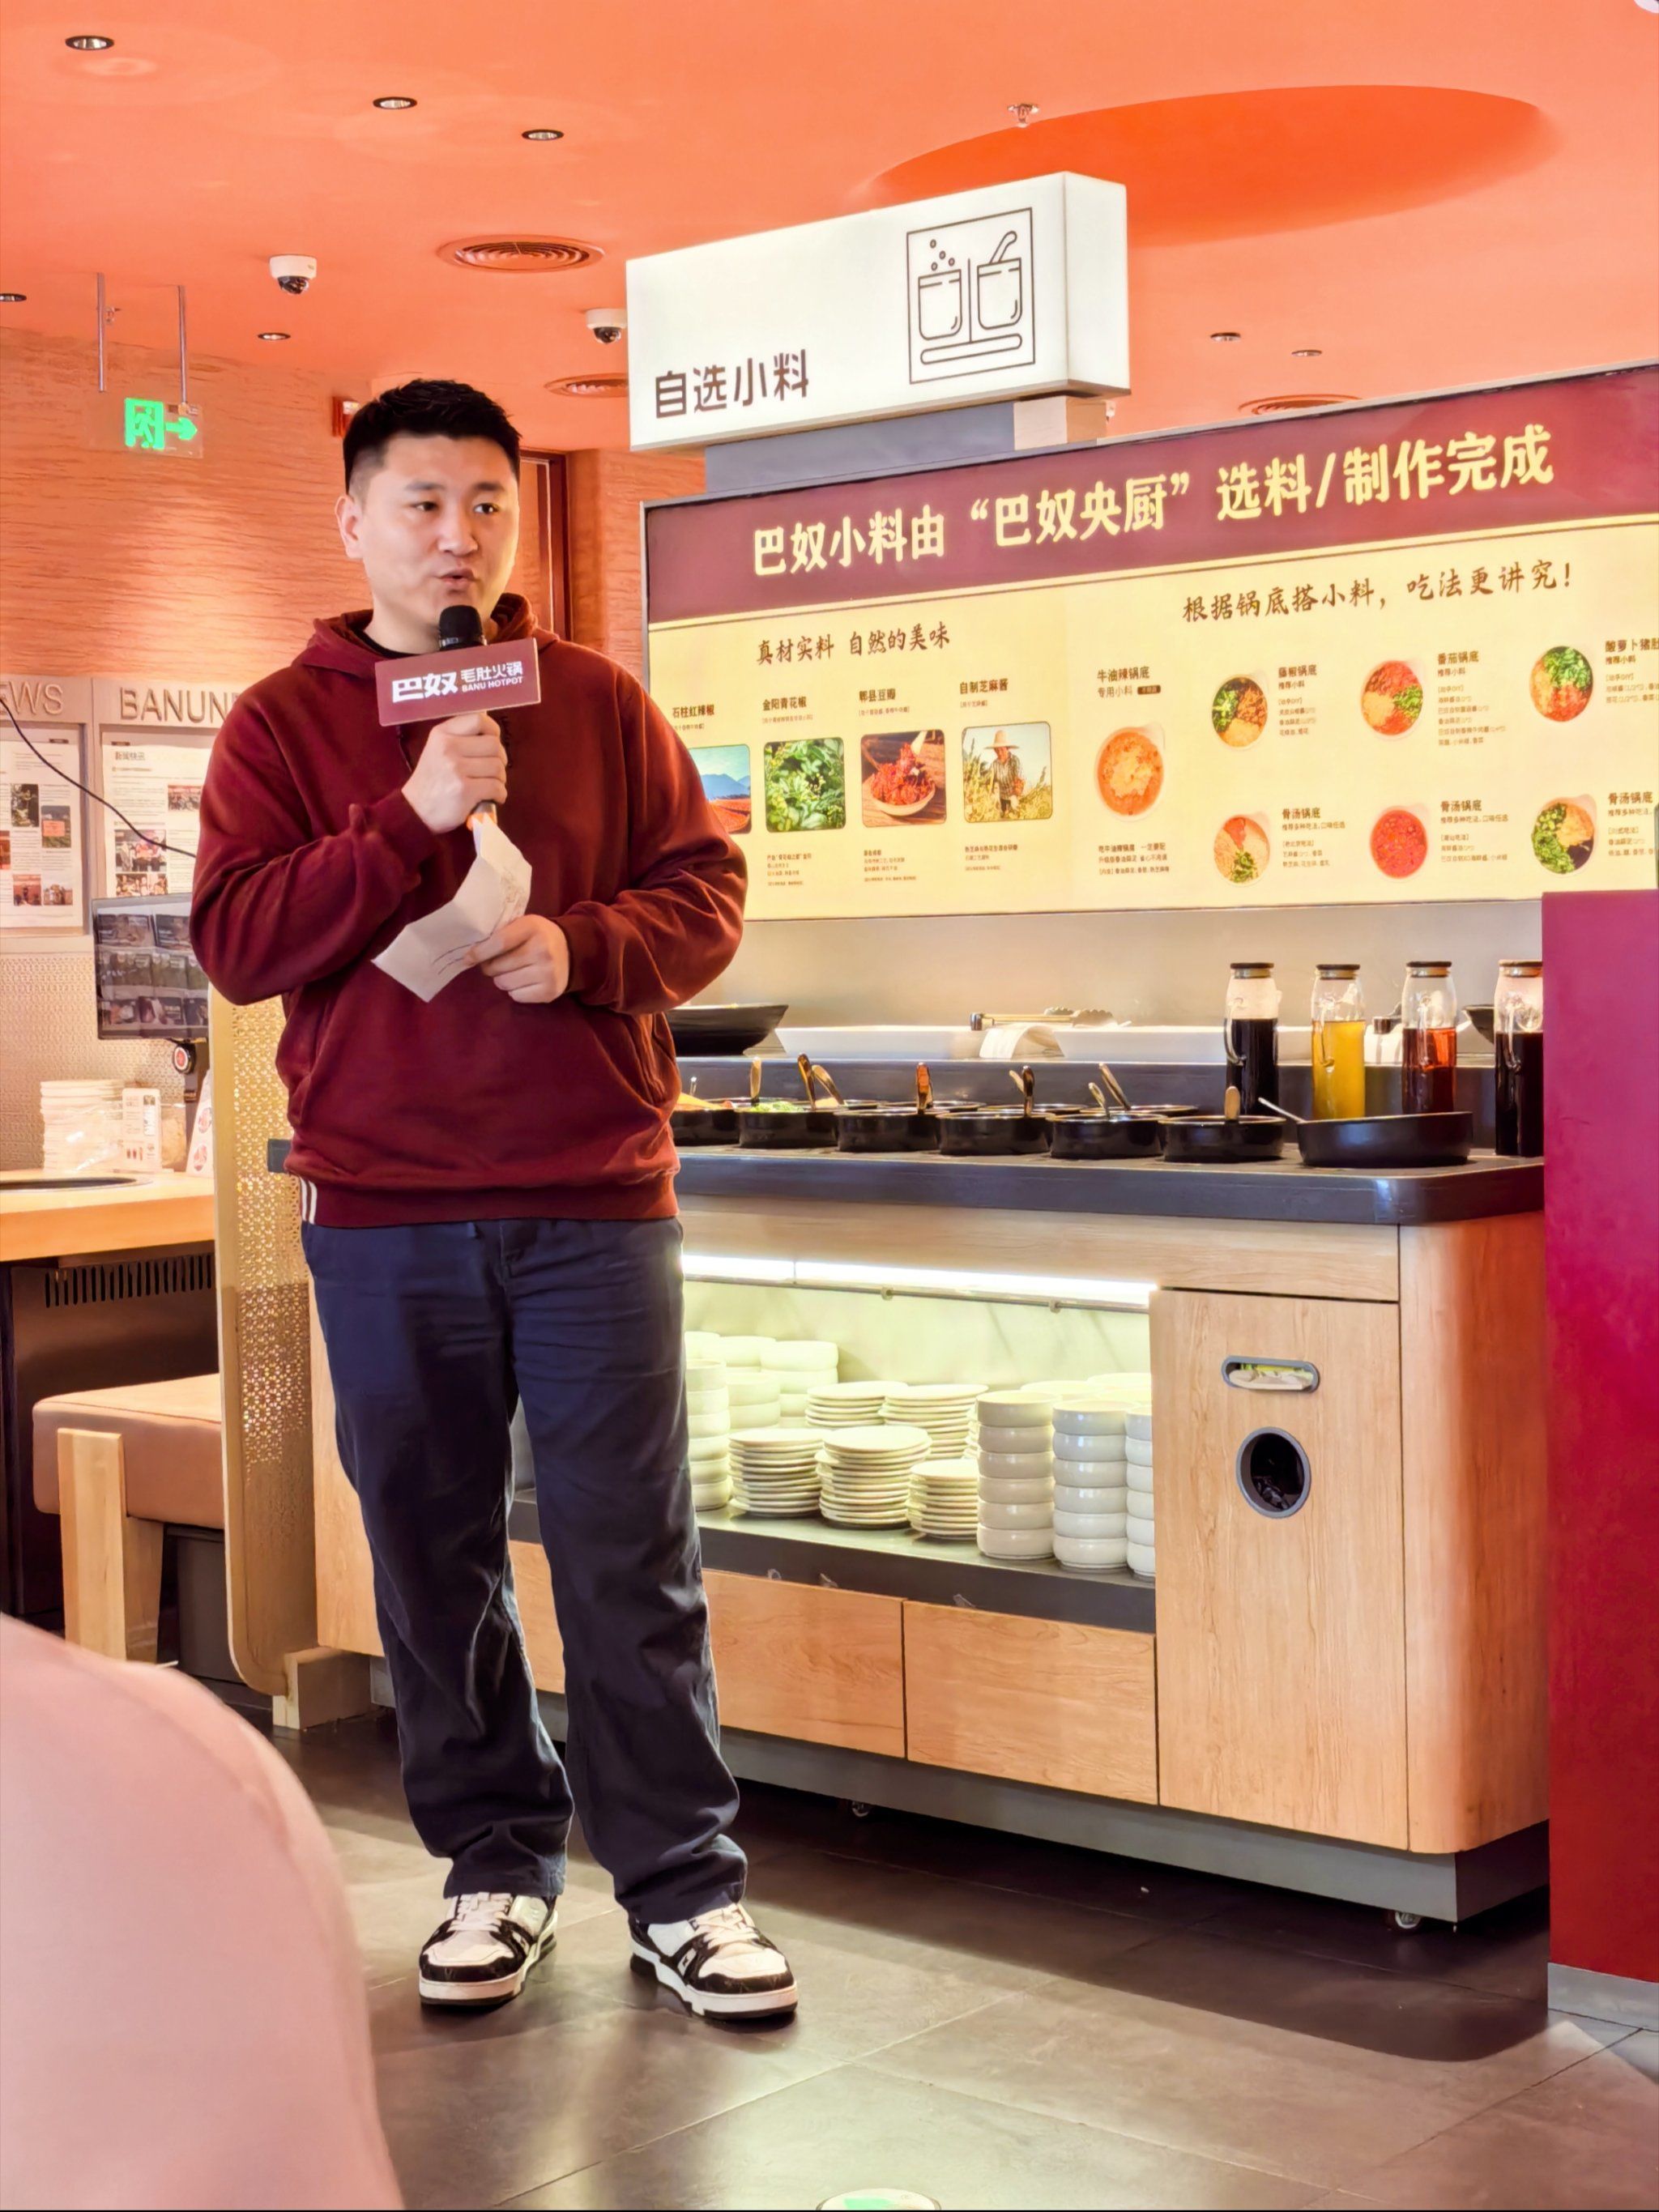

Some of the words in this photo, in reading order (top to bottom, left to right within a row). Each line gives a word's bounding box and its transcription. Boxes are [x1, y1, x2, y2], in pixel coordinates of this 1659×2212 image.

[655, 349, 808, 419] 自选小料
[753, 503, 946, 578] 巴奴小料由
[1215, 422, 1555, 521] 选料/制作完成
[756, 632, 835, 667] 真材实料
[848, 620, 951, 657] 自然的美味
[460, 661, 523, 684] 毛肚火锅
[1097, 666, 1150, 684] 牛油辣锅底
[392, 671, 458, 703] 巴奴
[461, 681, 486, 693] BANU
[488, 676, 524, 689] HOTPOT
[959, 678, 1009, 695] 自制芝麻酱
[672, 704, 715, 719] 石柱红辣椒
[762, 696, 807, 711] 金阳青花椒
[1440, 799, 1482, 812] 骨汤锅底
[1608, 791, 1653, 805] 骨汤锅底
[1282, 807, 1321, 820] 骨汤锅底
